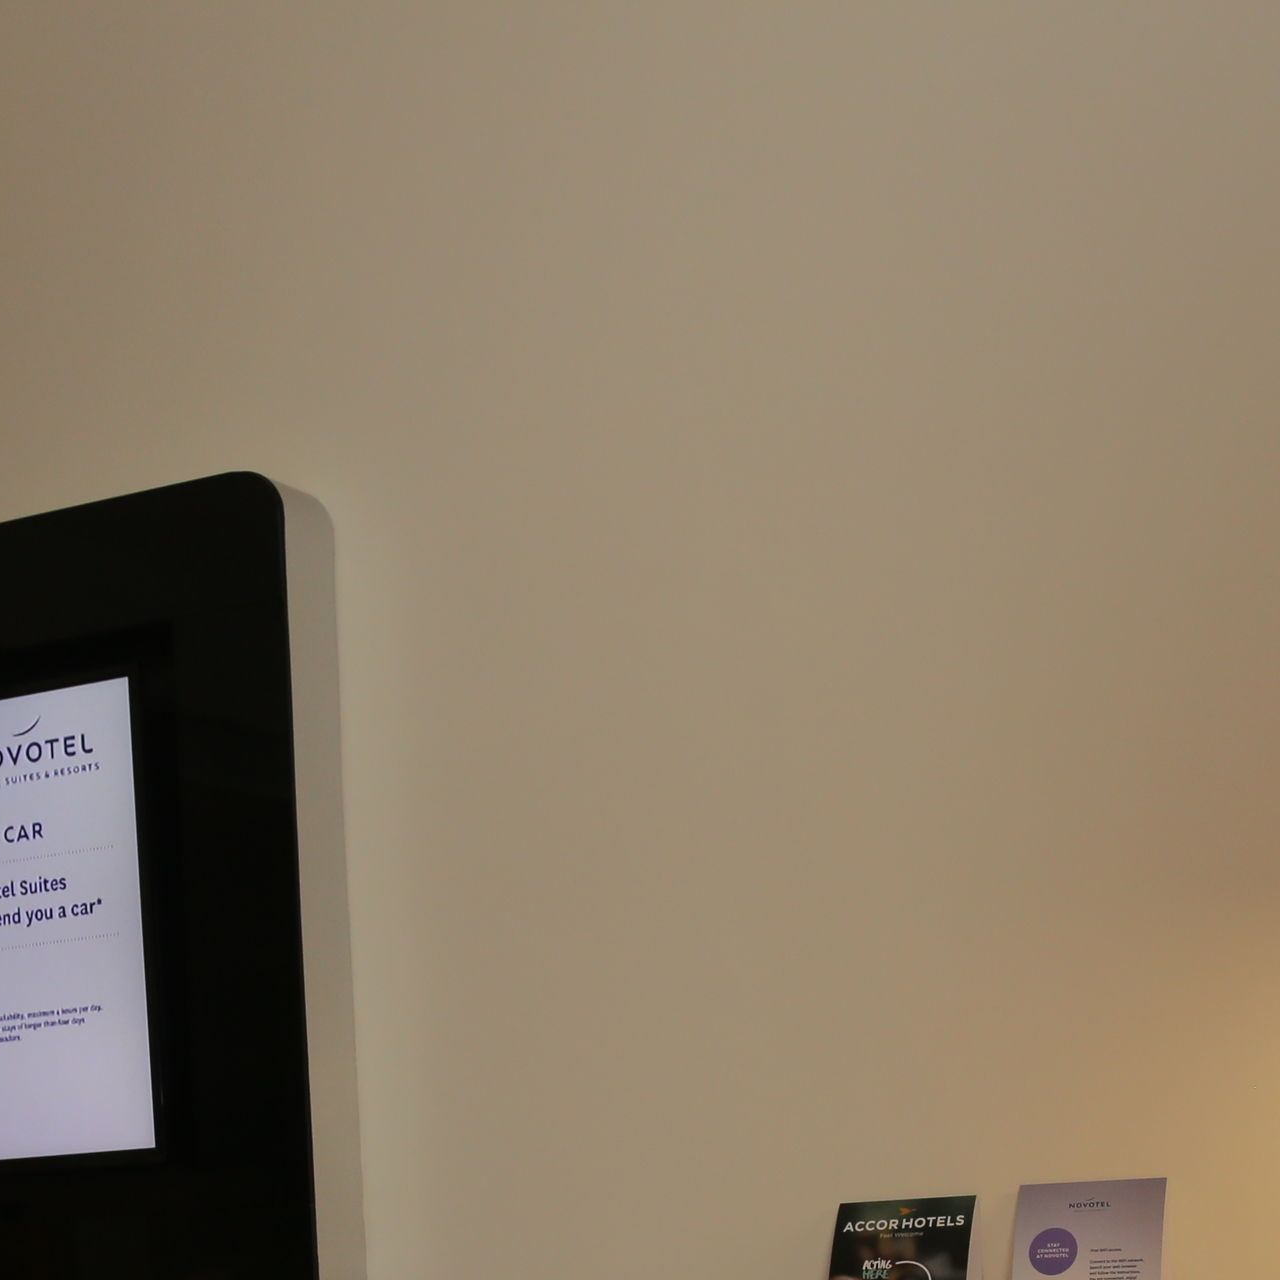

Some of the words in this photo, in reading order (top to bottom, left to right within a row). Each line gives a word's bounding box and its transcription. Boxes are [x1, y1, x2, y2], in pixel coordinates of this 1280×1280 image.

[5, 772, 41, 786] SUITES
[44, 770, 51, 779] &
[53, 762, 101, 777] RESORTS
[4, 822, 44, 843] CAR
[20, 876, 67, 896] Suites
[25, 907, 53, 927] you
[58, 905, 67, 918] a
[1068, 1201, 1111, 1209] NOVOTEL
[862, 1269, 889, 1280] HERE
